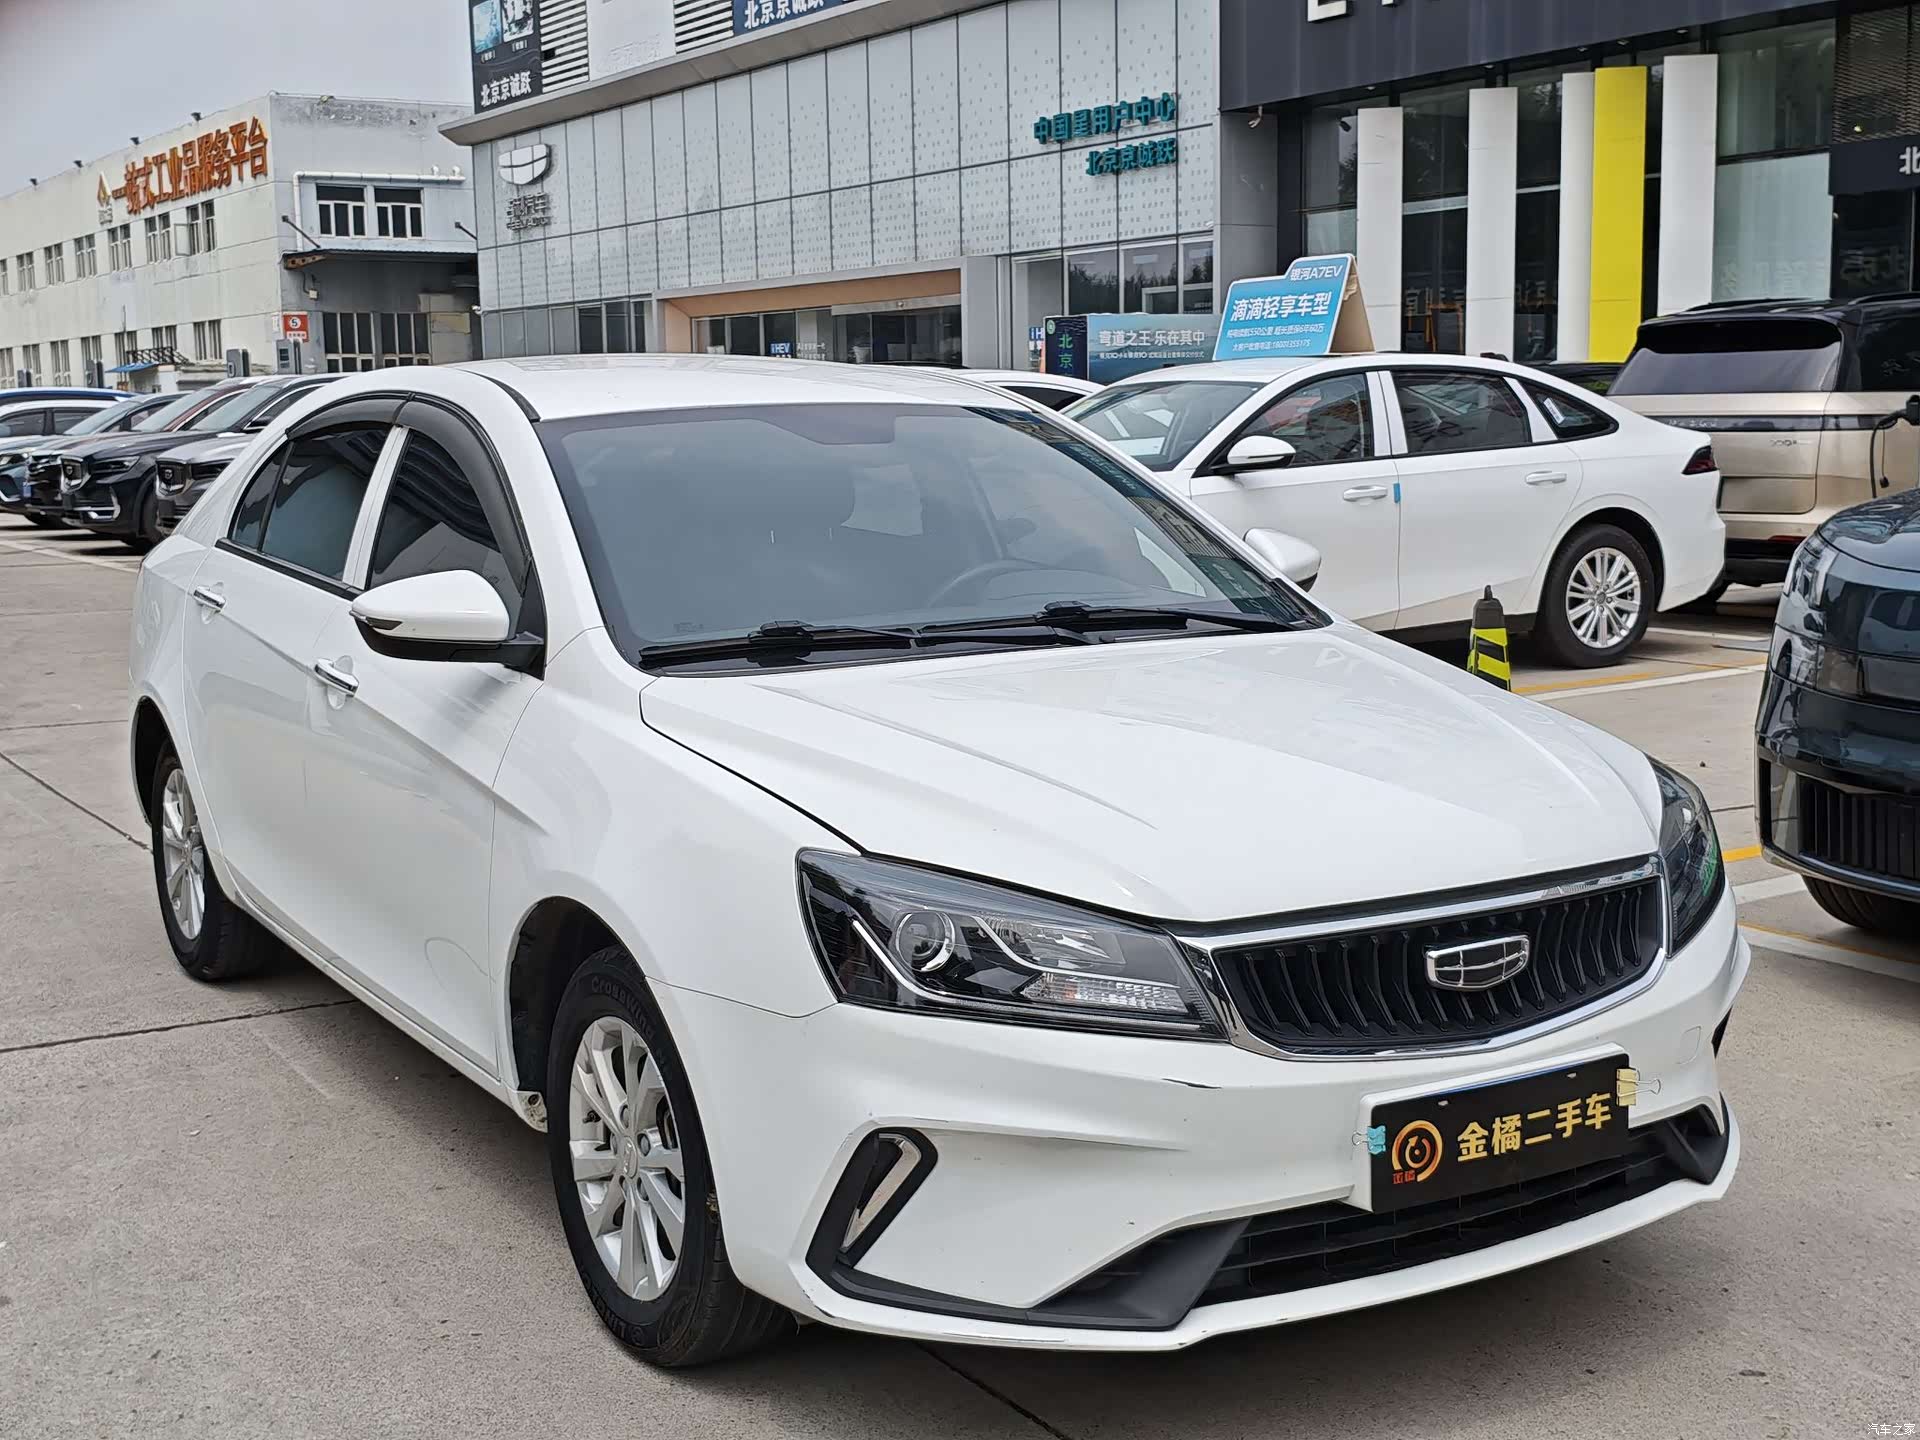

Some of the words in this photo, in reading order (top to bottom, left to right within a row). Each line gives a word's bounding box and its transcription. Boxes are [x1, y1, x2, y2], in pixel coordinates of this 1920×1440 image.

[480, 70, 532, 108] 北京京诚跃
[1034, 92, 1176, 145] 中国星用户中心
[112, 116, 268, 215] 一站式工业品服务平台
[1086, 138, 1176, 176] 北京京诚跃
[1290, 265, 1343, 281] 银河A7EV
[1230, 291, 1332, 322] 滴滴轻享车型
[1058, 333, 1073, 370] 北京
[1457, 1092, 1612, 1162] 金橘二手车
